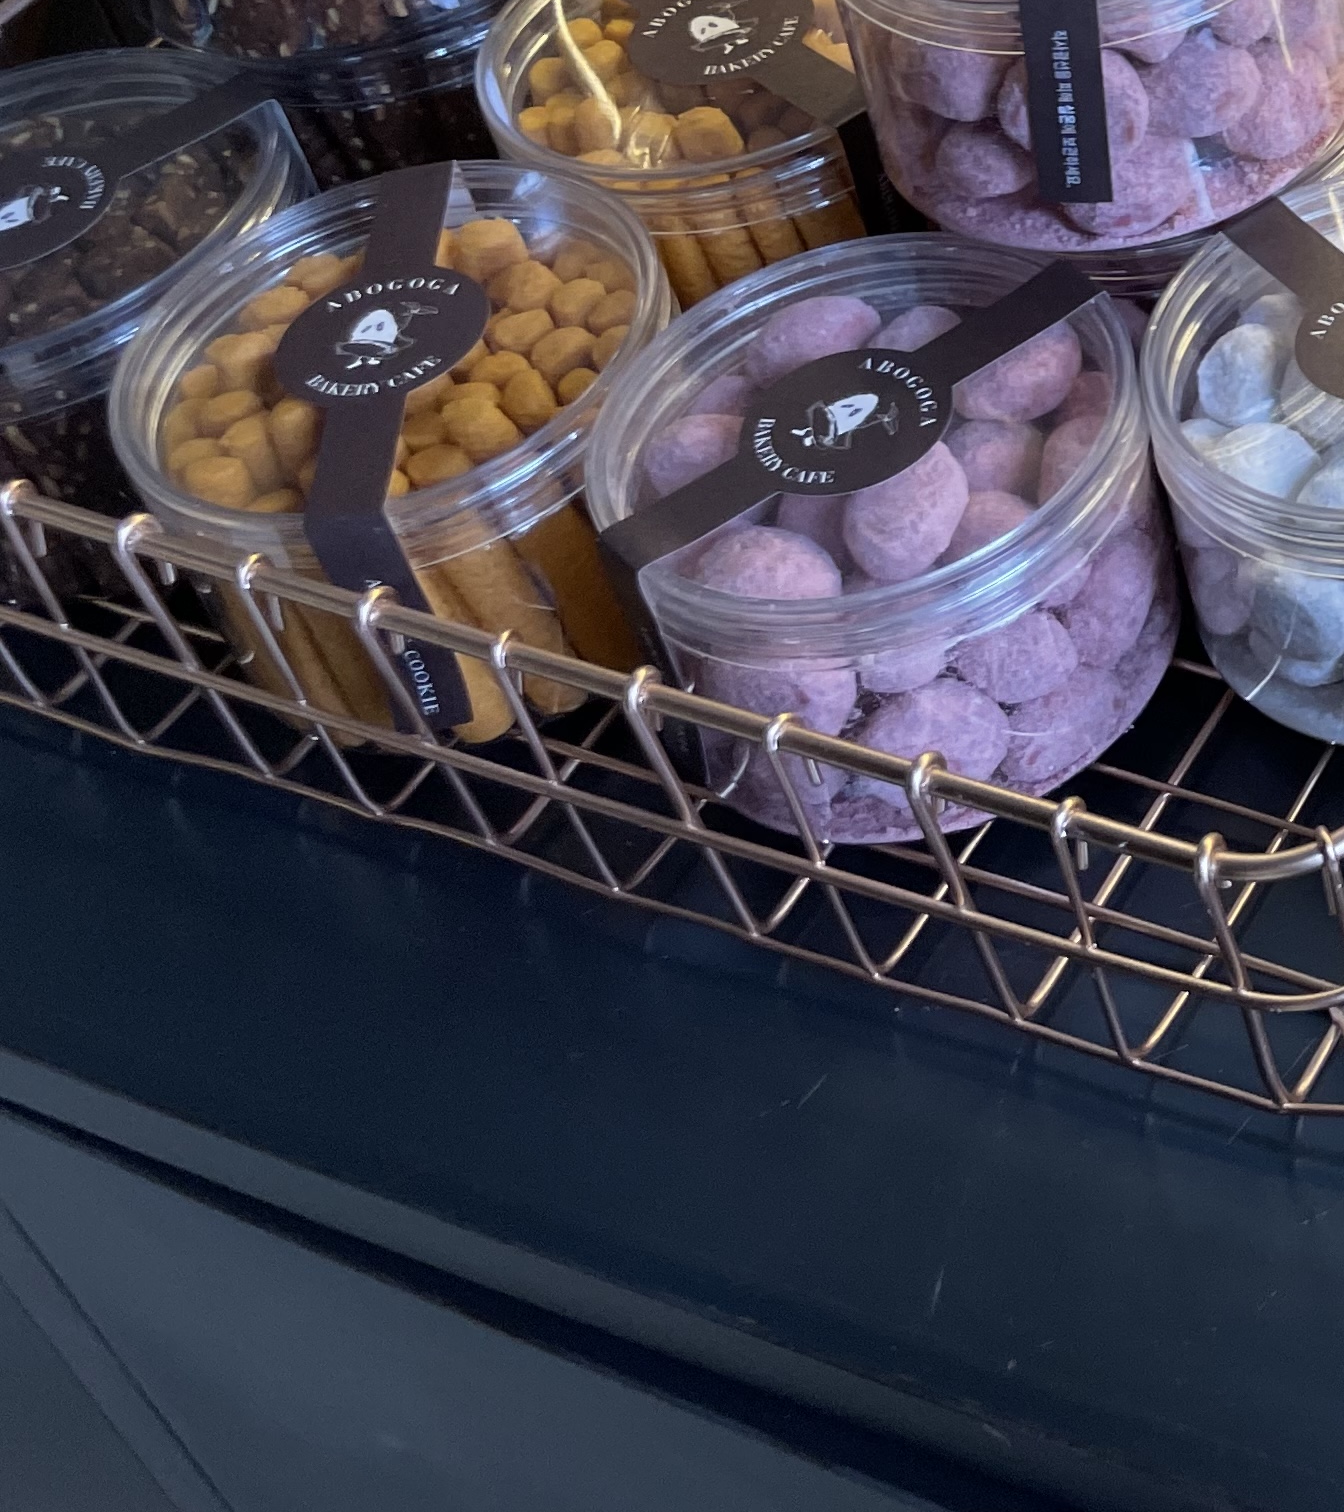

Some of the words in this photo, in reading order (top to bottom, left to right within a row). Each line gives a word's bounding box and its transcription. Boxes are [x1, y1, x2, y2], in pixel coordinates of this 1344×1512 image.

[326, 277, 461, 313] ABOGOGA
[858, 357, 938, 427] ABOGOGA
[753, 417, 784, 473] BAKERY
[781, 469, 836, 485] CAFE
[403, 650, 440, 716] COOKIE
